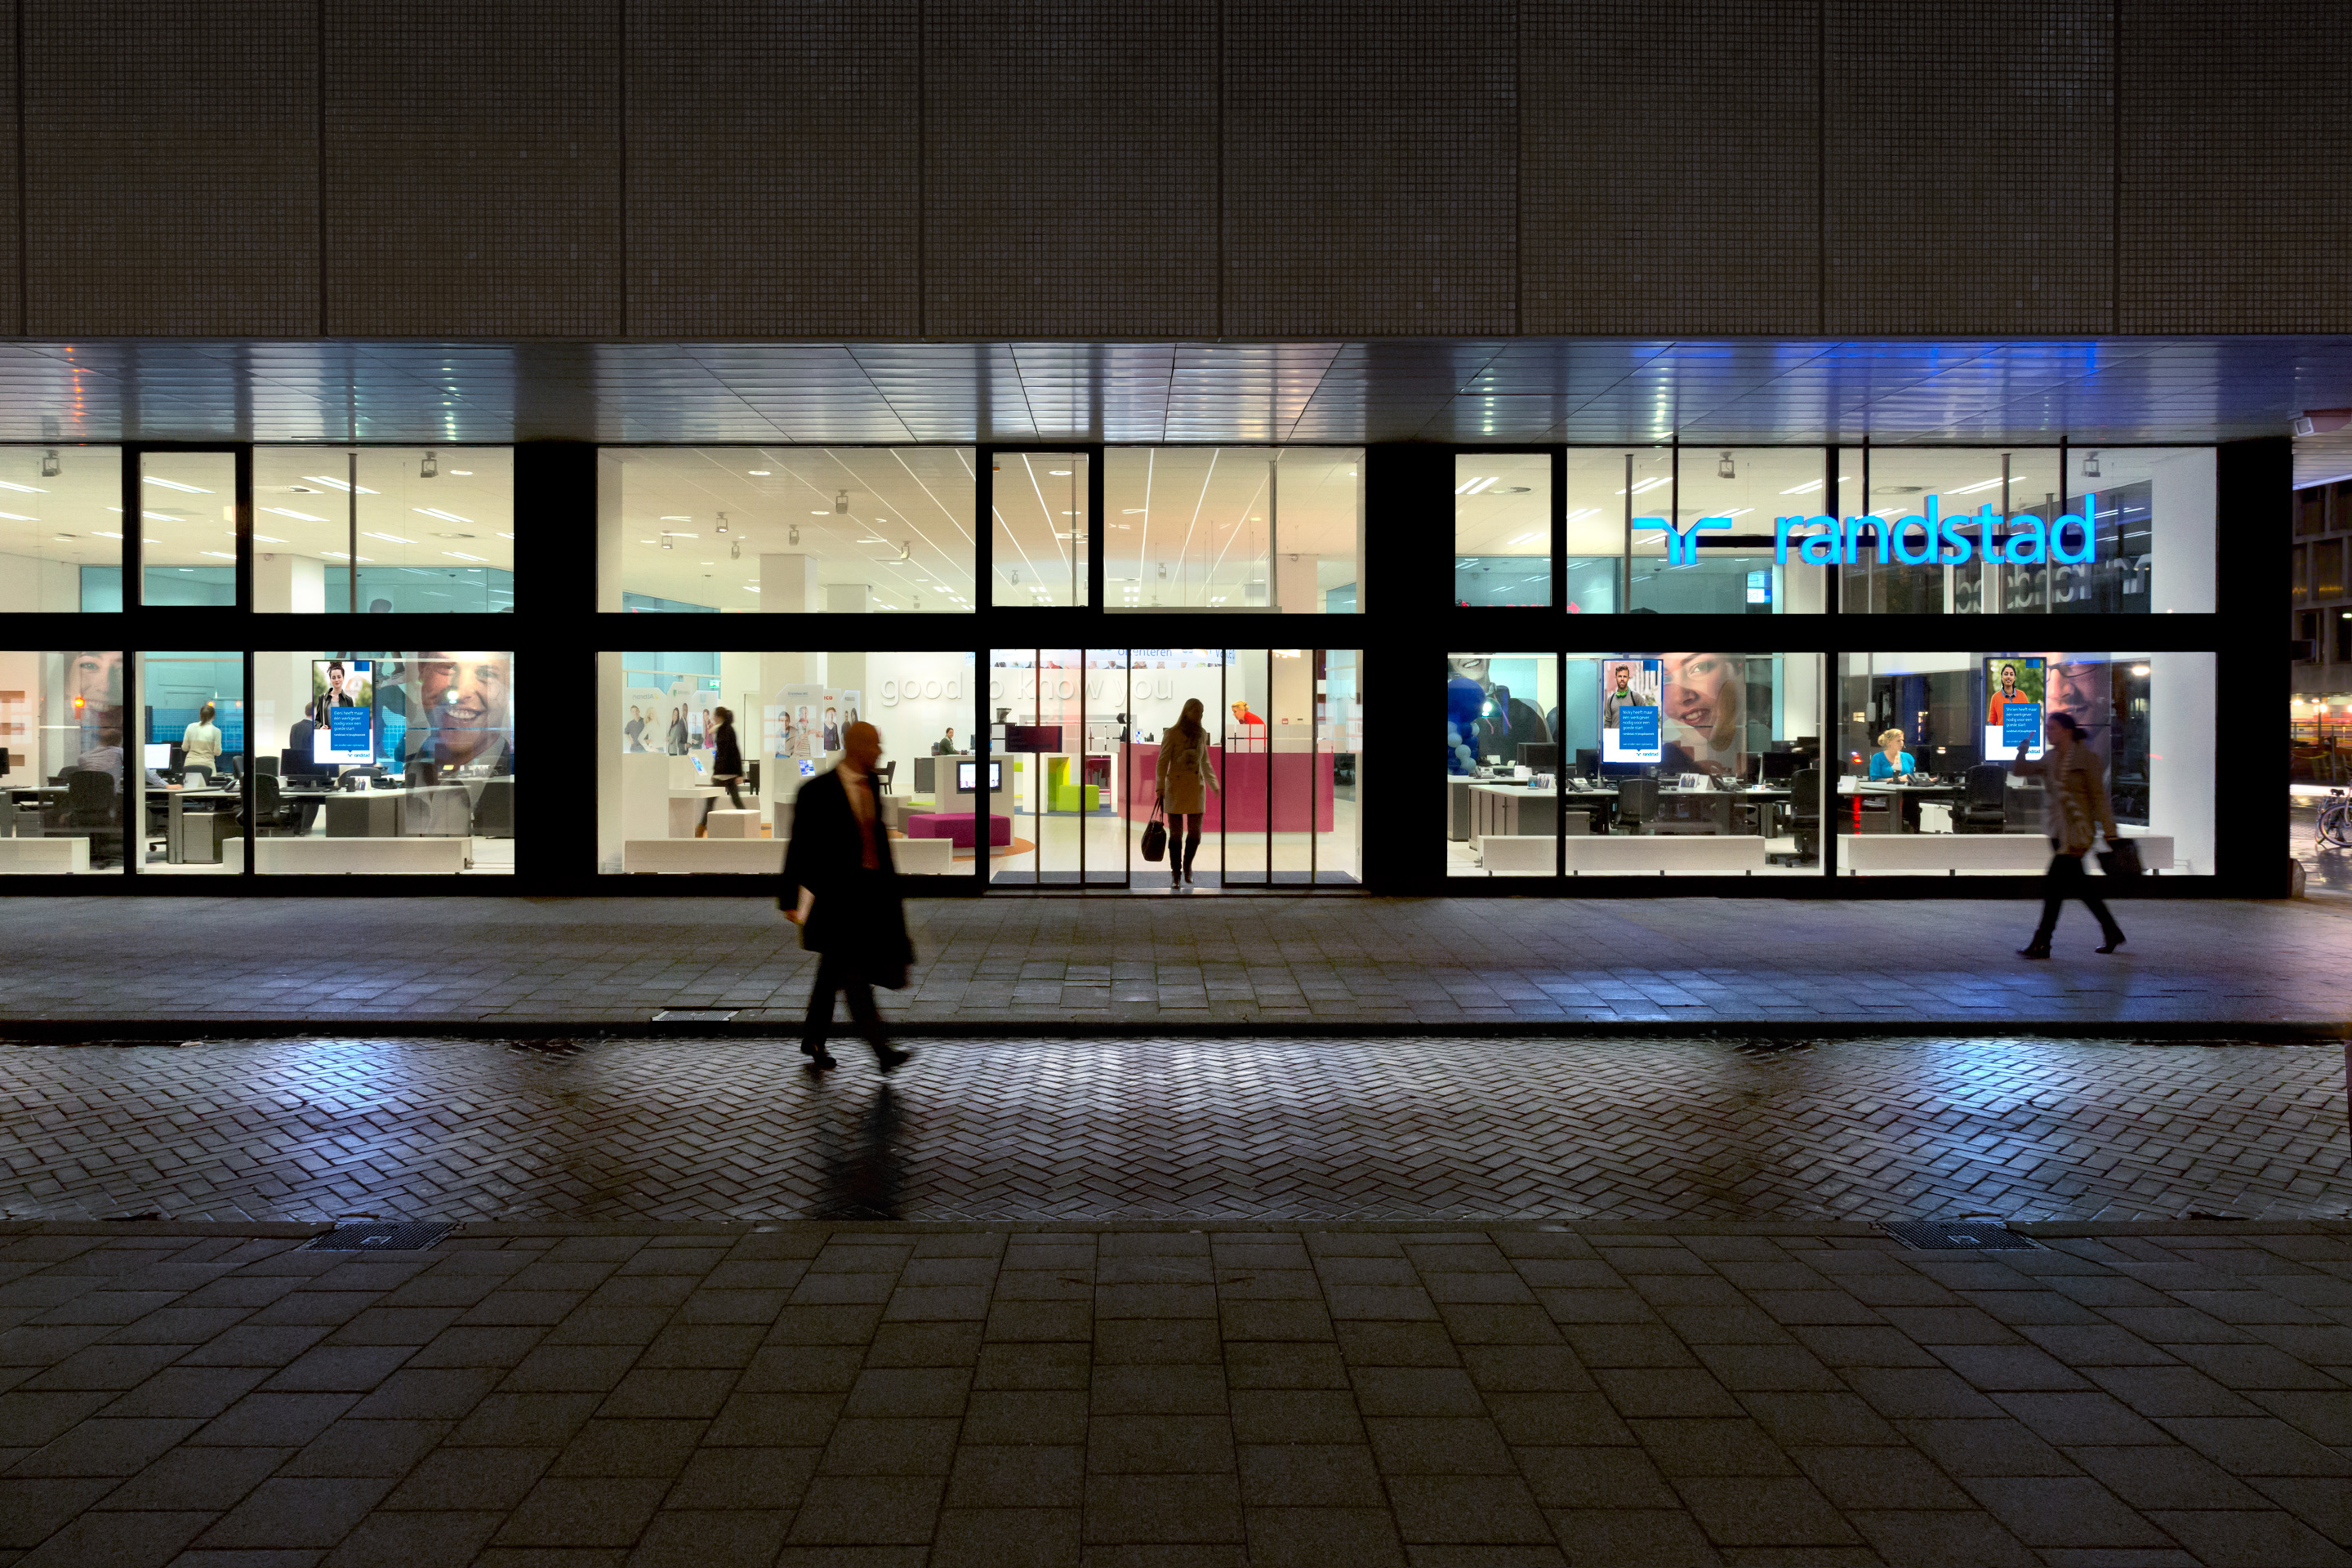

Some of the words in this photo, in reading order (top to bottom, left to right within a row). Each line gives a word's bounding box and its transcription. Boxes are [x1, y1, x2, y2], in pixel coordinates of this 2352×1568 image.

[1775, 494, 2096, 566] randstad
[880, 671, 963, 707] good
[1018, 671, 1104, 701] know
[1112, 678, 1174, 708] you
